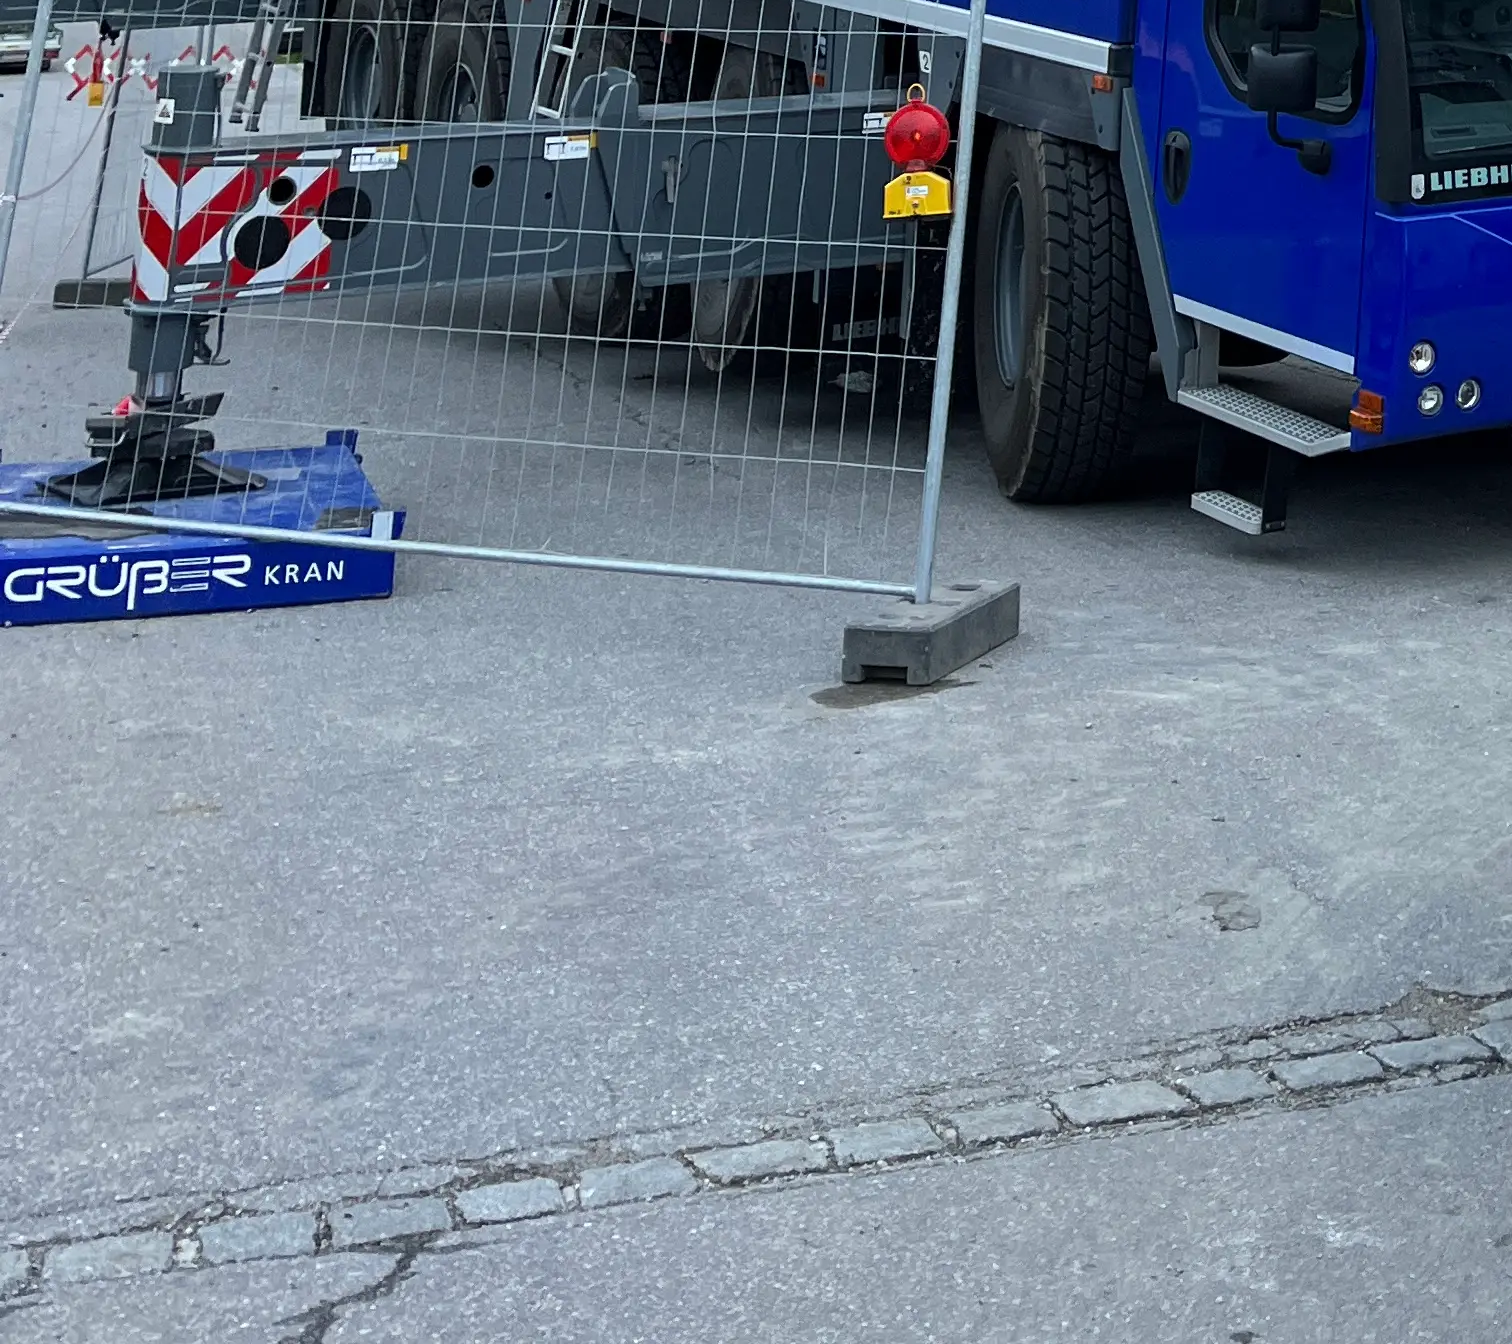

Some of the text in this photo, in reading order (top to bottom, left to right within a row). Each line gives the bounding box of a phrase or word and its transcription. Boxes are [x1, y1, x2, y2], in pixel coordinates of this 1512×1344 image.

[922, 55, 930, 71] 2
[4, 554, 345, 610] GRÜßER KRAN
